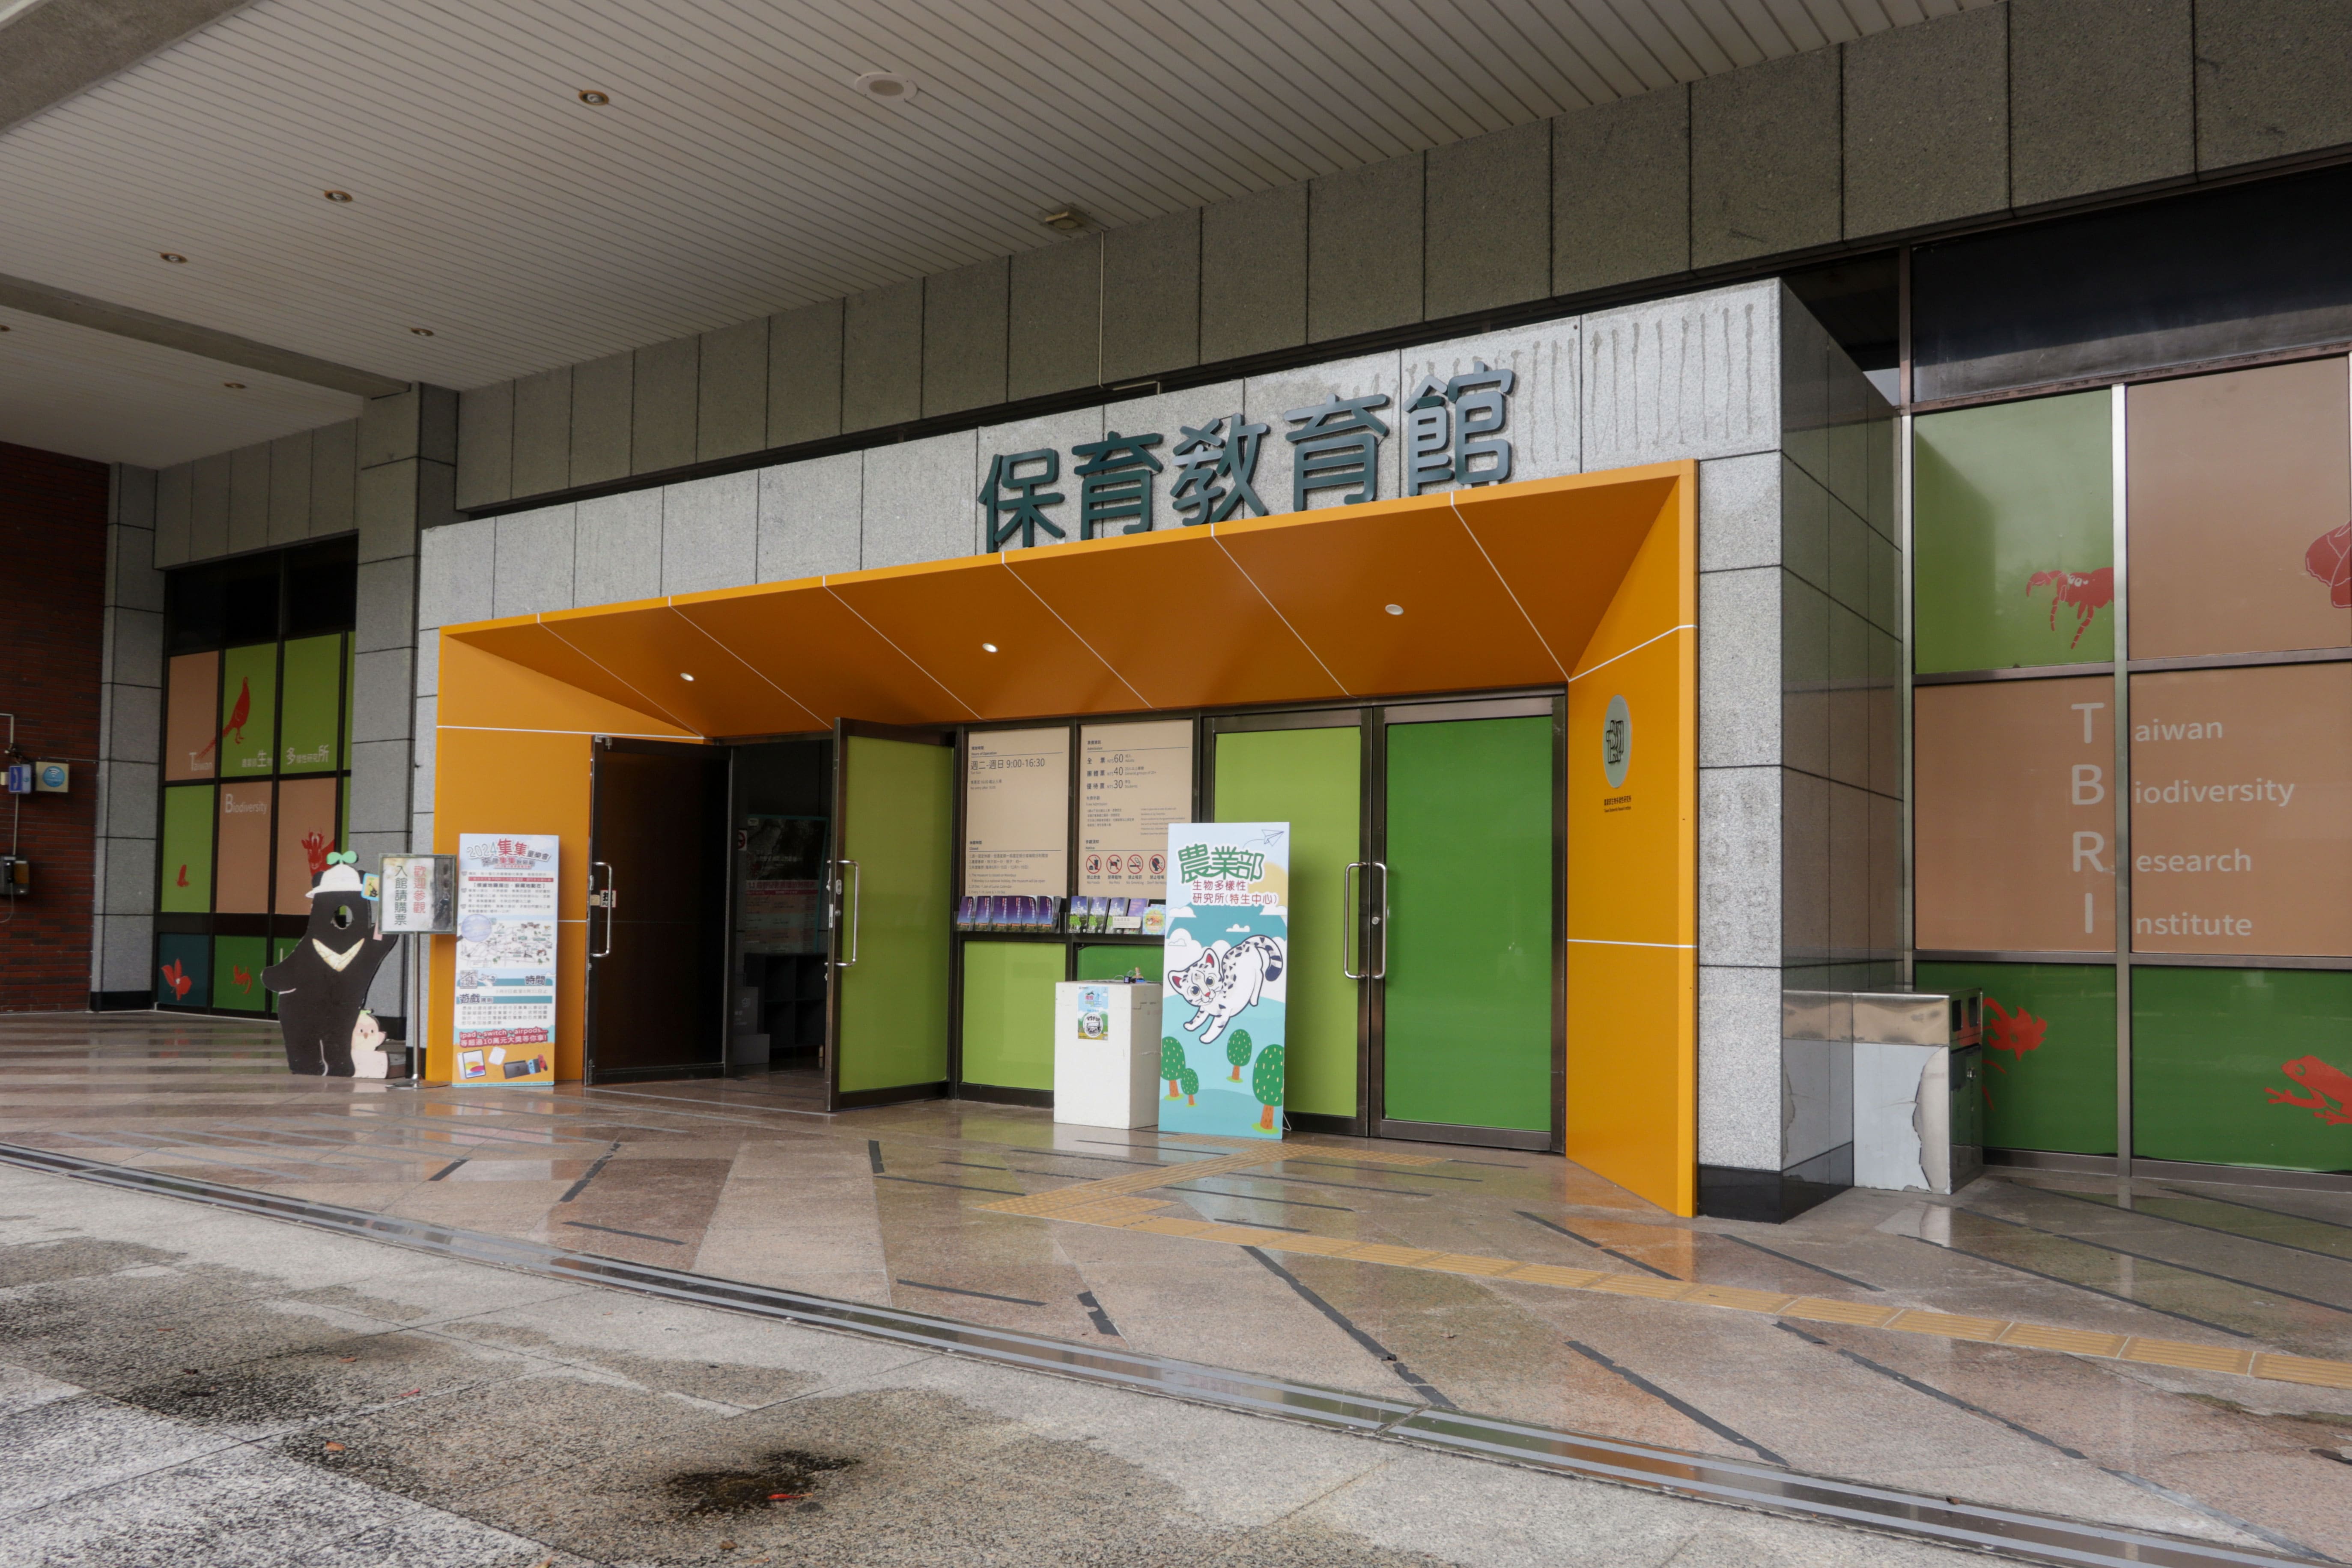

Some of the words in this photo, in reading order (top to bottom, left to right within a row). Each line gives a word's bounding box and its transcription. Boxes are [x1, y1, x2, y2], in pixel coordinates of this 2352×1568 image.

[978, 361, 1515, 553] 保育教育館
[189, 752, 213, 771] Taiwan
[971, 760, 1004, 770] 週二-週日
[1007, 758, 1045, 768] 9:00-16:30
[225, 793, 268, 814] Biodiversity
[1178, 844, 1264, 884] 農業部
[394, 865, 408, 925] 入館請購票
[414, 865, 426, 913] 歡迎參觀
[1192, 880, 1246, 891] 生物多樣性
[1192, 893, 1277, 904] 研究所(特生中心)
[525, 975, 545, 985] 時間
